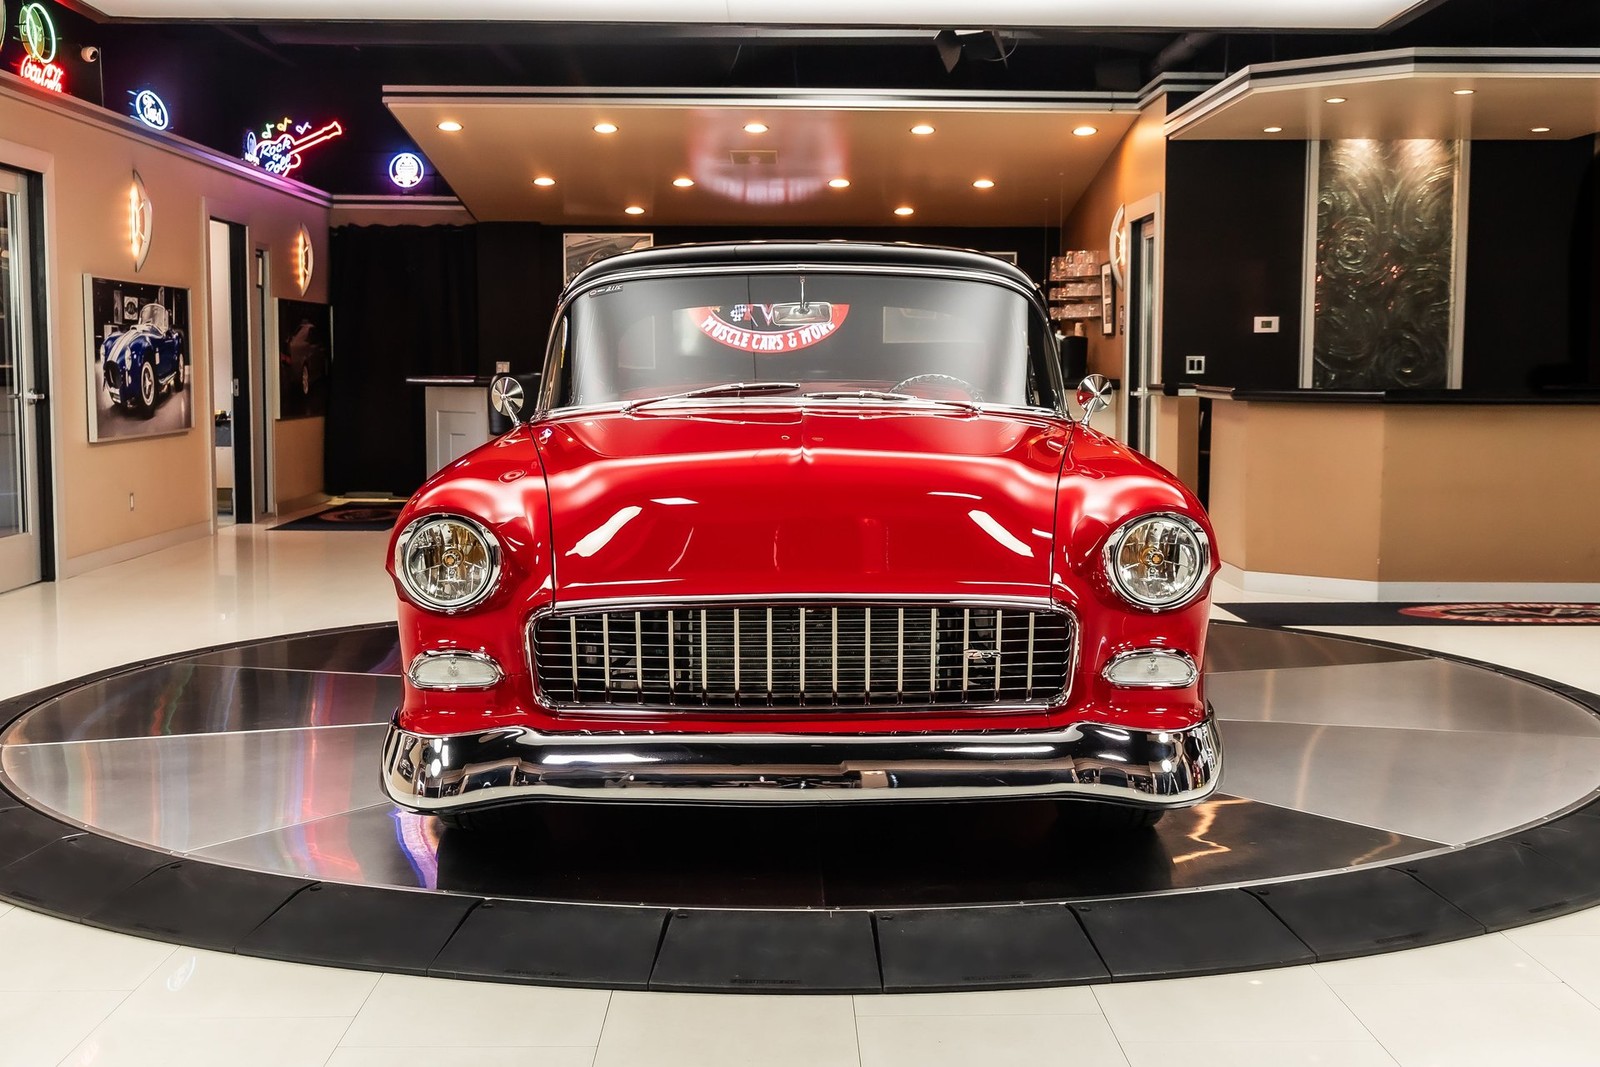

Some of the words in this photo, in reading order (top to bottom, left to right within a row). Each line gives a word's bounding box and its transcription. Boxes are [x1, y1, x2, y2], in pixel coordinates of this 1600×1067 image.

[260, 136, 291, 158] Rock
[700, 316, 749, 349] MUSCLE
[751, 334, 784, 351] CARS
[786, 332, 798, 349] &
